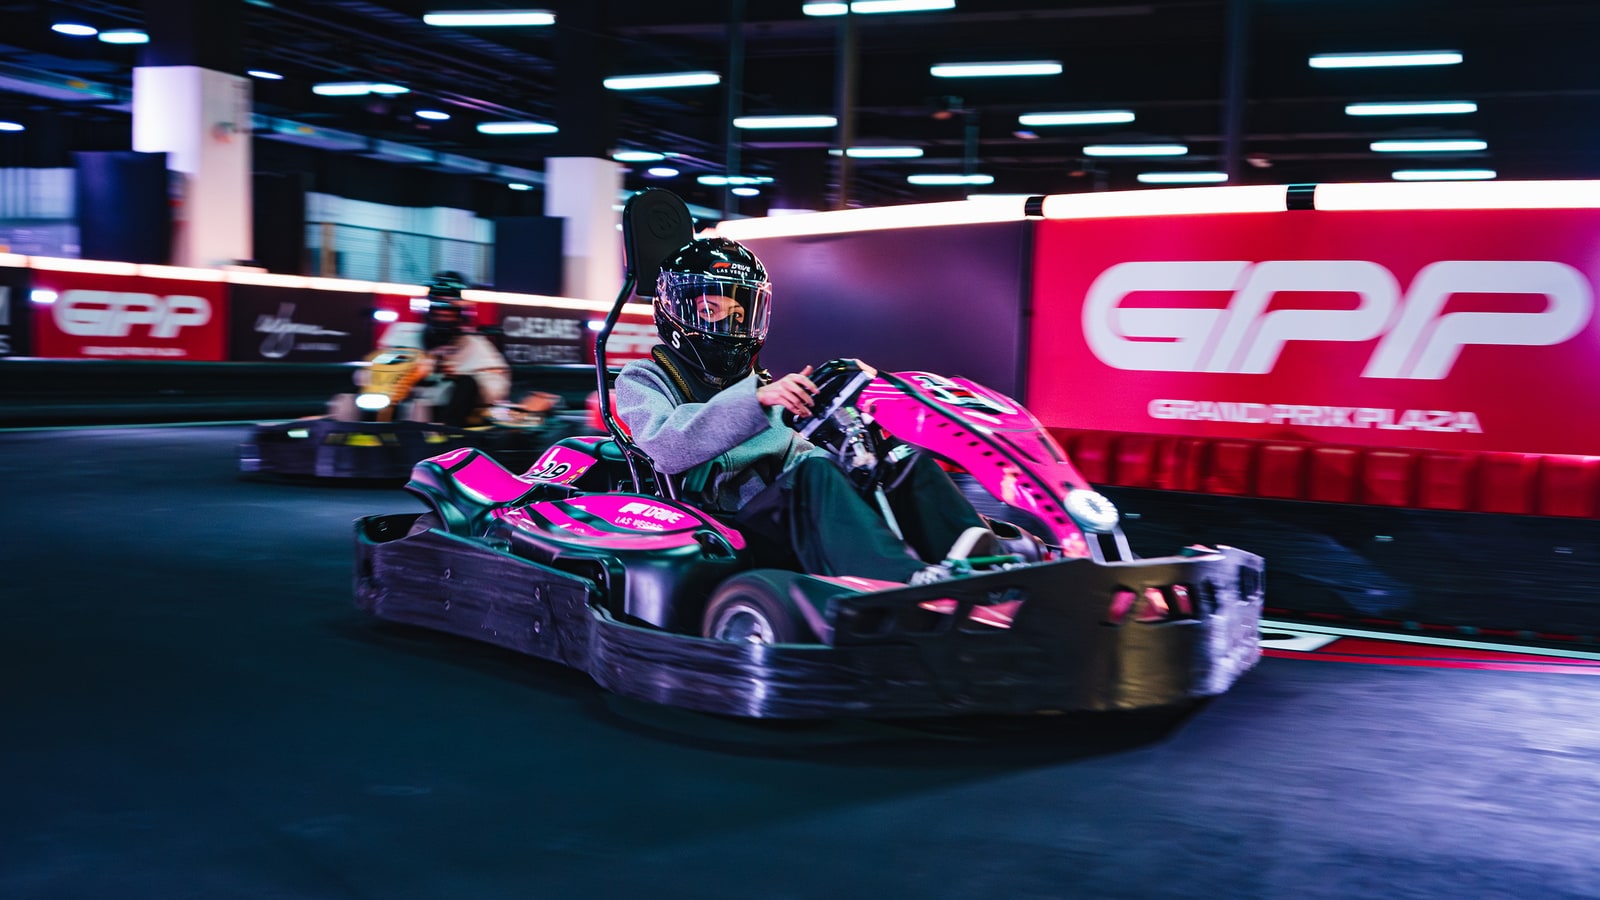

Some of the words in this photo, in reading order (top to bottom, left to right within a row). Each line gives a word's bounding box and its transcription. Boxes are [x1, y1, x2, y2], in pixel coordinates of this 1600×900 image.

[731, 263, 751, 273] DRIVE
[53, 288, 211, 338] GPP
[1080, 259, 1594, 381] GPP
[1147, 399, 1268, 424] GRAND
[1268, 404, 1351, 428] PRIX
[1352, 407, 1484, 434] PLAZA
[615, 516, 632, 525] LAS
[643, 506, 685, 524] DRIVE
